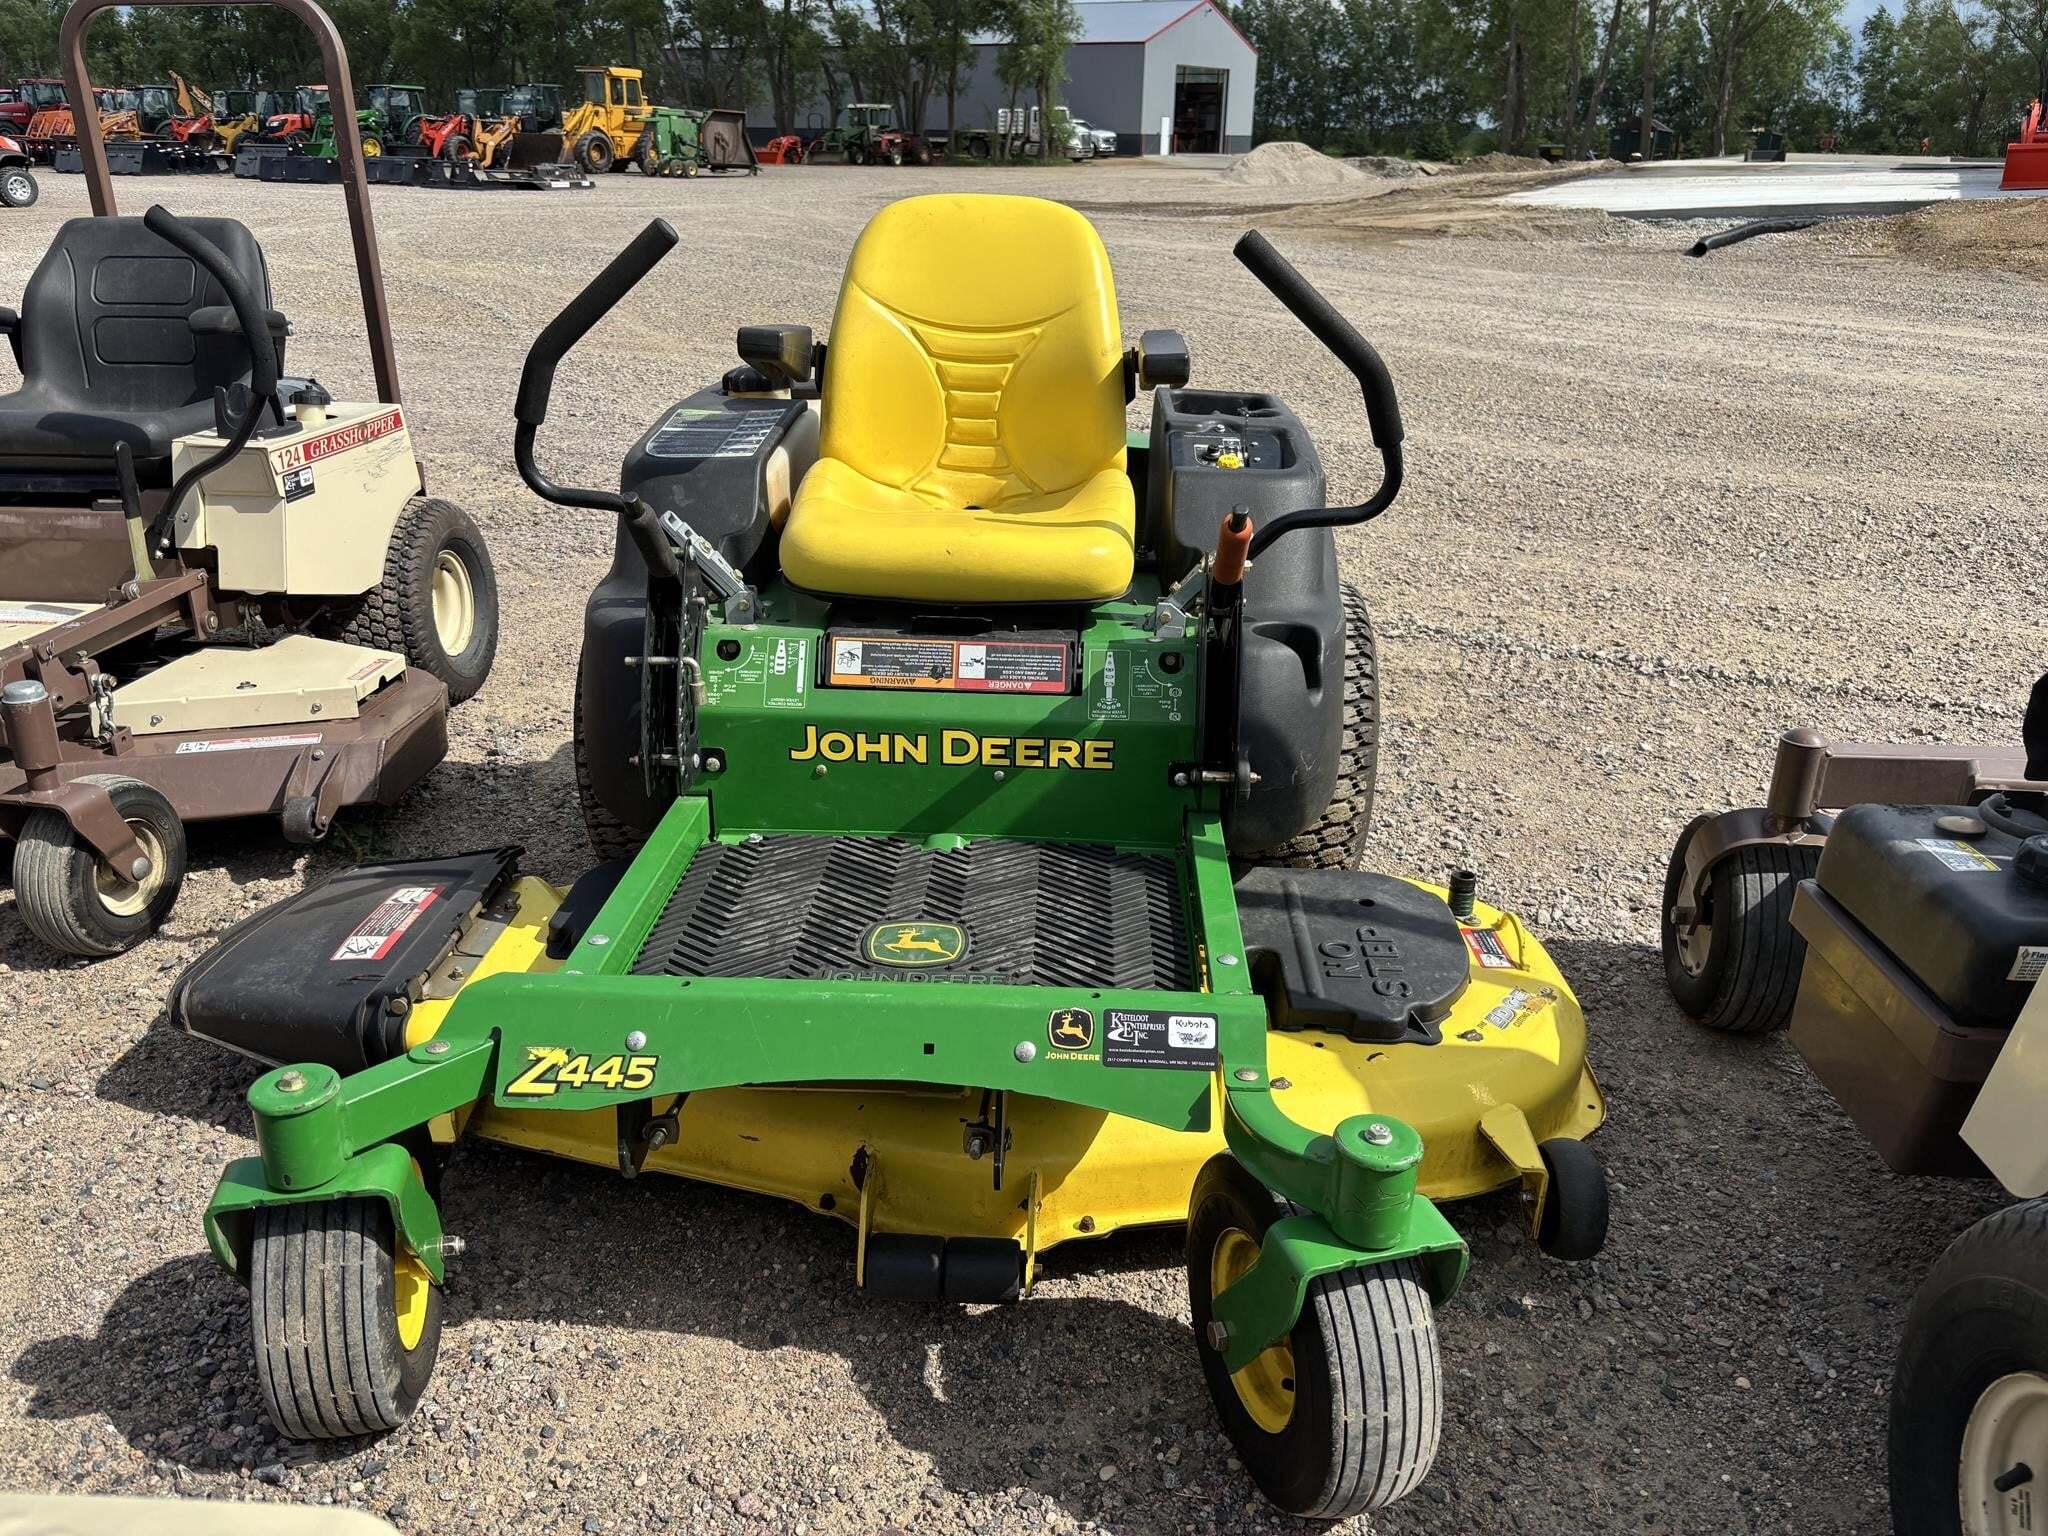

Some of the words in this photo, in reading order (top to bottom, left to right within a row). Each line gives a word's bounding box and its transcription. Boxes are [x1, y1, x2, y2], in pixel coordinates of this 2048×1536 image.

[278, 447, 302, 470] 124
[310, 415, 396, 458] GRASSHOPPER
[869, 677, 911, 685] WARNING
[988, 681, 1024, 689] DANGER
[789, 724, 928, 765] JOHN
[941, 729, 1115, 770] DEERE
[1318, 940, 1362, 979] NO
[1356, 926, 1413, 998] STEP
[818, 968, 899, 984] JOHN
[1110, 1012, 1149, 1028] KESTELOOT
[1175, 1019, 1209, 1029] Kubota
[1123, 1022, 1166, 1037] ENTERPRISES
[1045, 1051, 1070, 1060] JOHN
[1071, 1052, 1100, 1061] DEERE
[502, 1047, 661, 1097] Z445
